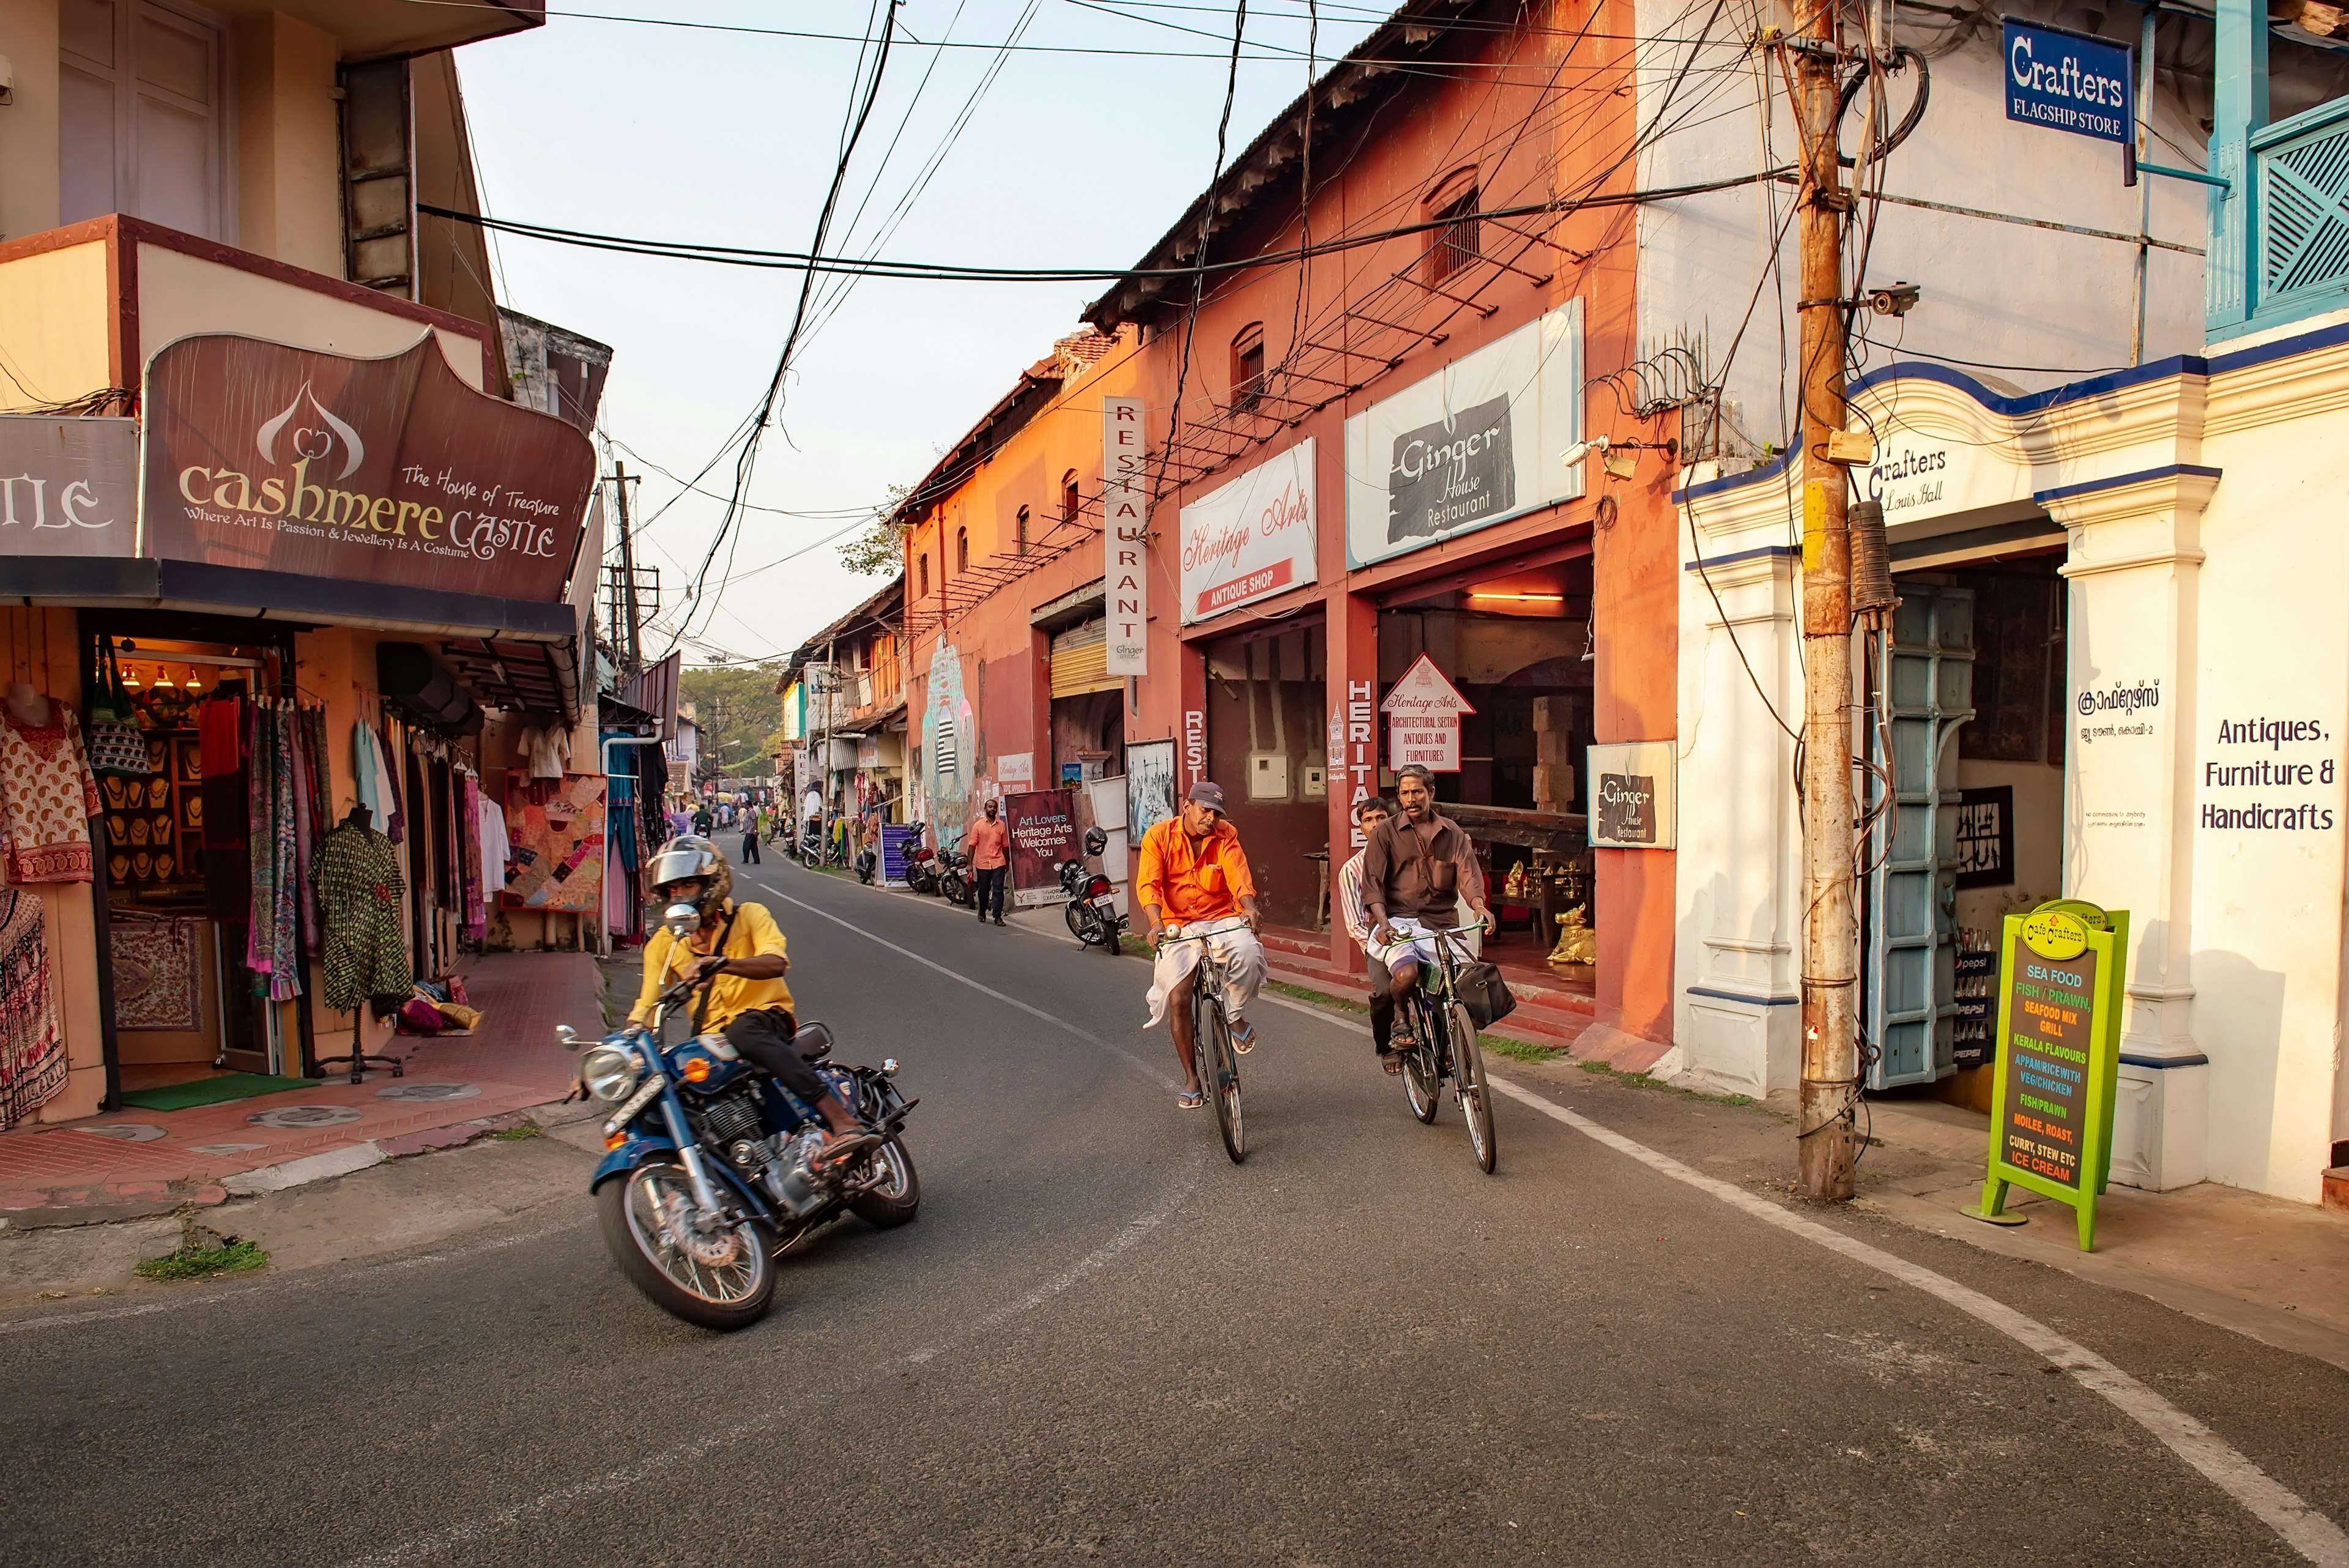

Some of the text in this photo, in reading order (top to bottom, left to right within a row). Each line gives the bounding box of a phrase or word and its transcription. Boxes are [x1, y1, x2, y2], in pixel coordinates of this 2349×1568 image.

[2012, 35, 2123, 108] Crafters
[2014, 98, 2121, 136] FLAGSHIP STORE
[1398, 426, 1501, 483] Ginger
[1436, 463, 1480, 504] House
[1869, 449, 1946, 502] Crafters
[402, 464, 560, 516] The House of Treasure
[1882, 481, 1943, 513] Louis Hall
[179, 456, 557, 560] cashmere CASTLE
[1116, 406, 1139, 638] RESTAURANT
[1428, 491, 1491, 528] Restaurant
[184, 507, 470, 559] Where Art Is Passion & Jewellery Is A Costume
[1183, 480, 1308, 572] Heritage Arts
[1211, 570, 1274, 607] ANTIQUE SHOP
[1116, 644, 1144, 657] Ginger
[1387, 694, 1457, 713] Heritage Arts
[1392, 716, 1458, 728] ARCHITECTURAL SECTION
[2217, 717, 2330, 751] Antiques,
[1403, 733, 1447, 745] ANTIQUES AND
[1406, 750, 1444, 762] FURNITURES
[2205, 759, 2336, 787] Furniture &
[1603, 779, 1650, 814] Ginger
[1019, 814, 1067, 826] Art Lovers
[1621, 804, 1642, 826] House
[2202, 803, 2334, 831] Handicrafts
[1012, 823, 1072, 838] Heritage Arts
[1020, 836, 1067, 848] Welcomes
[1617, 825, 1647, 839] Restaurant
[1035, 847, 1053, 857] You
[2027, 923, 2082, 945] Cafe Crafters
[1962, 957, 1987, 970] pepsi
[2027, 965, 2082, 987] SEA FOOD
[1959, 1004, 1985, 1015] PEPSI
[2016, 982, 2091, 1013] FISH / PRAWN,
[2024, 1000, 2077, 1025] SEAFOOD MIX
[2040, 1020, 2063, 1037] GRILL
[1953, 1049, 1981, 1058] PEPSI
[2014, 1033, 2086, 1065] KERALA FLAVOURS
[2021, 1071, 2072, 1097] VEG/CHICKEN
[2020, 1093, 2067, 1119] FISH/PRAWN
[2014, 1113, 2073, 1145] MOILEE, ROAST,
[2009, 1135, 2076, 1167] CURRY, STEW ETC
[2012, 1151, 2070, 1181] ICE CREAM
